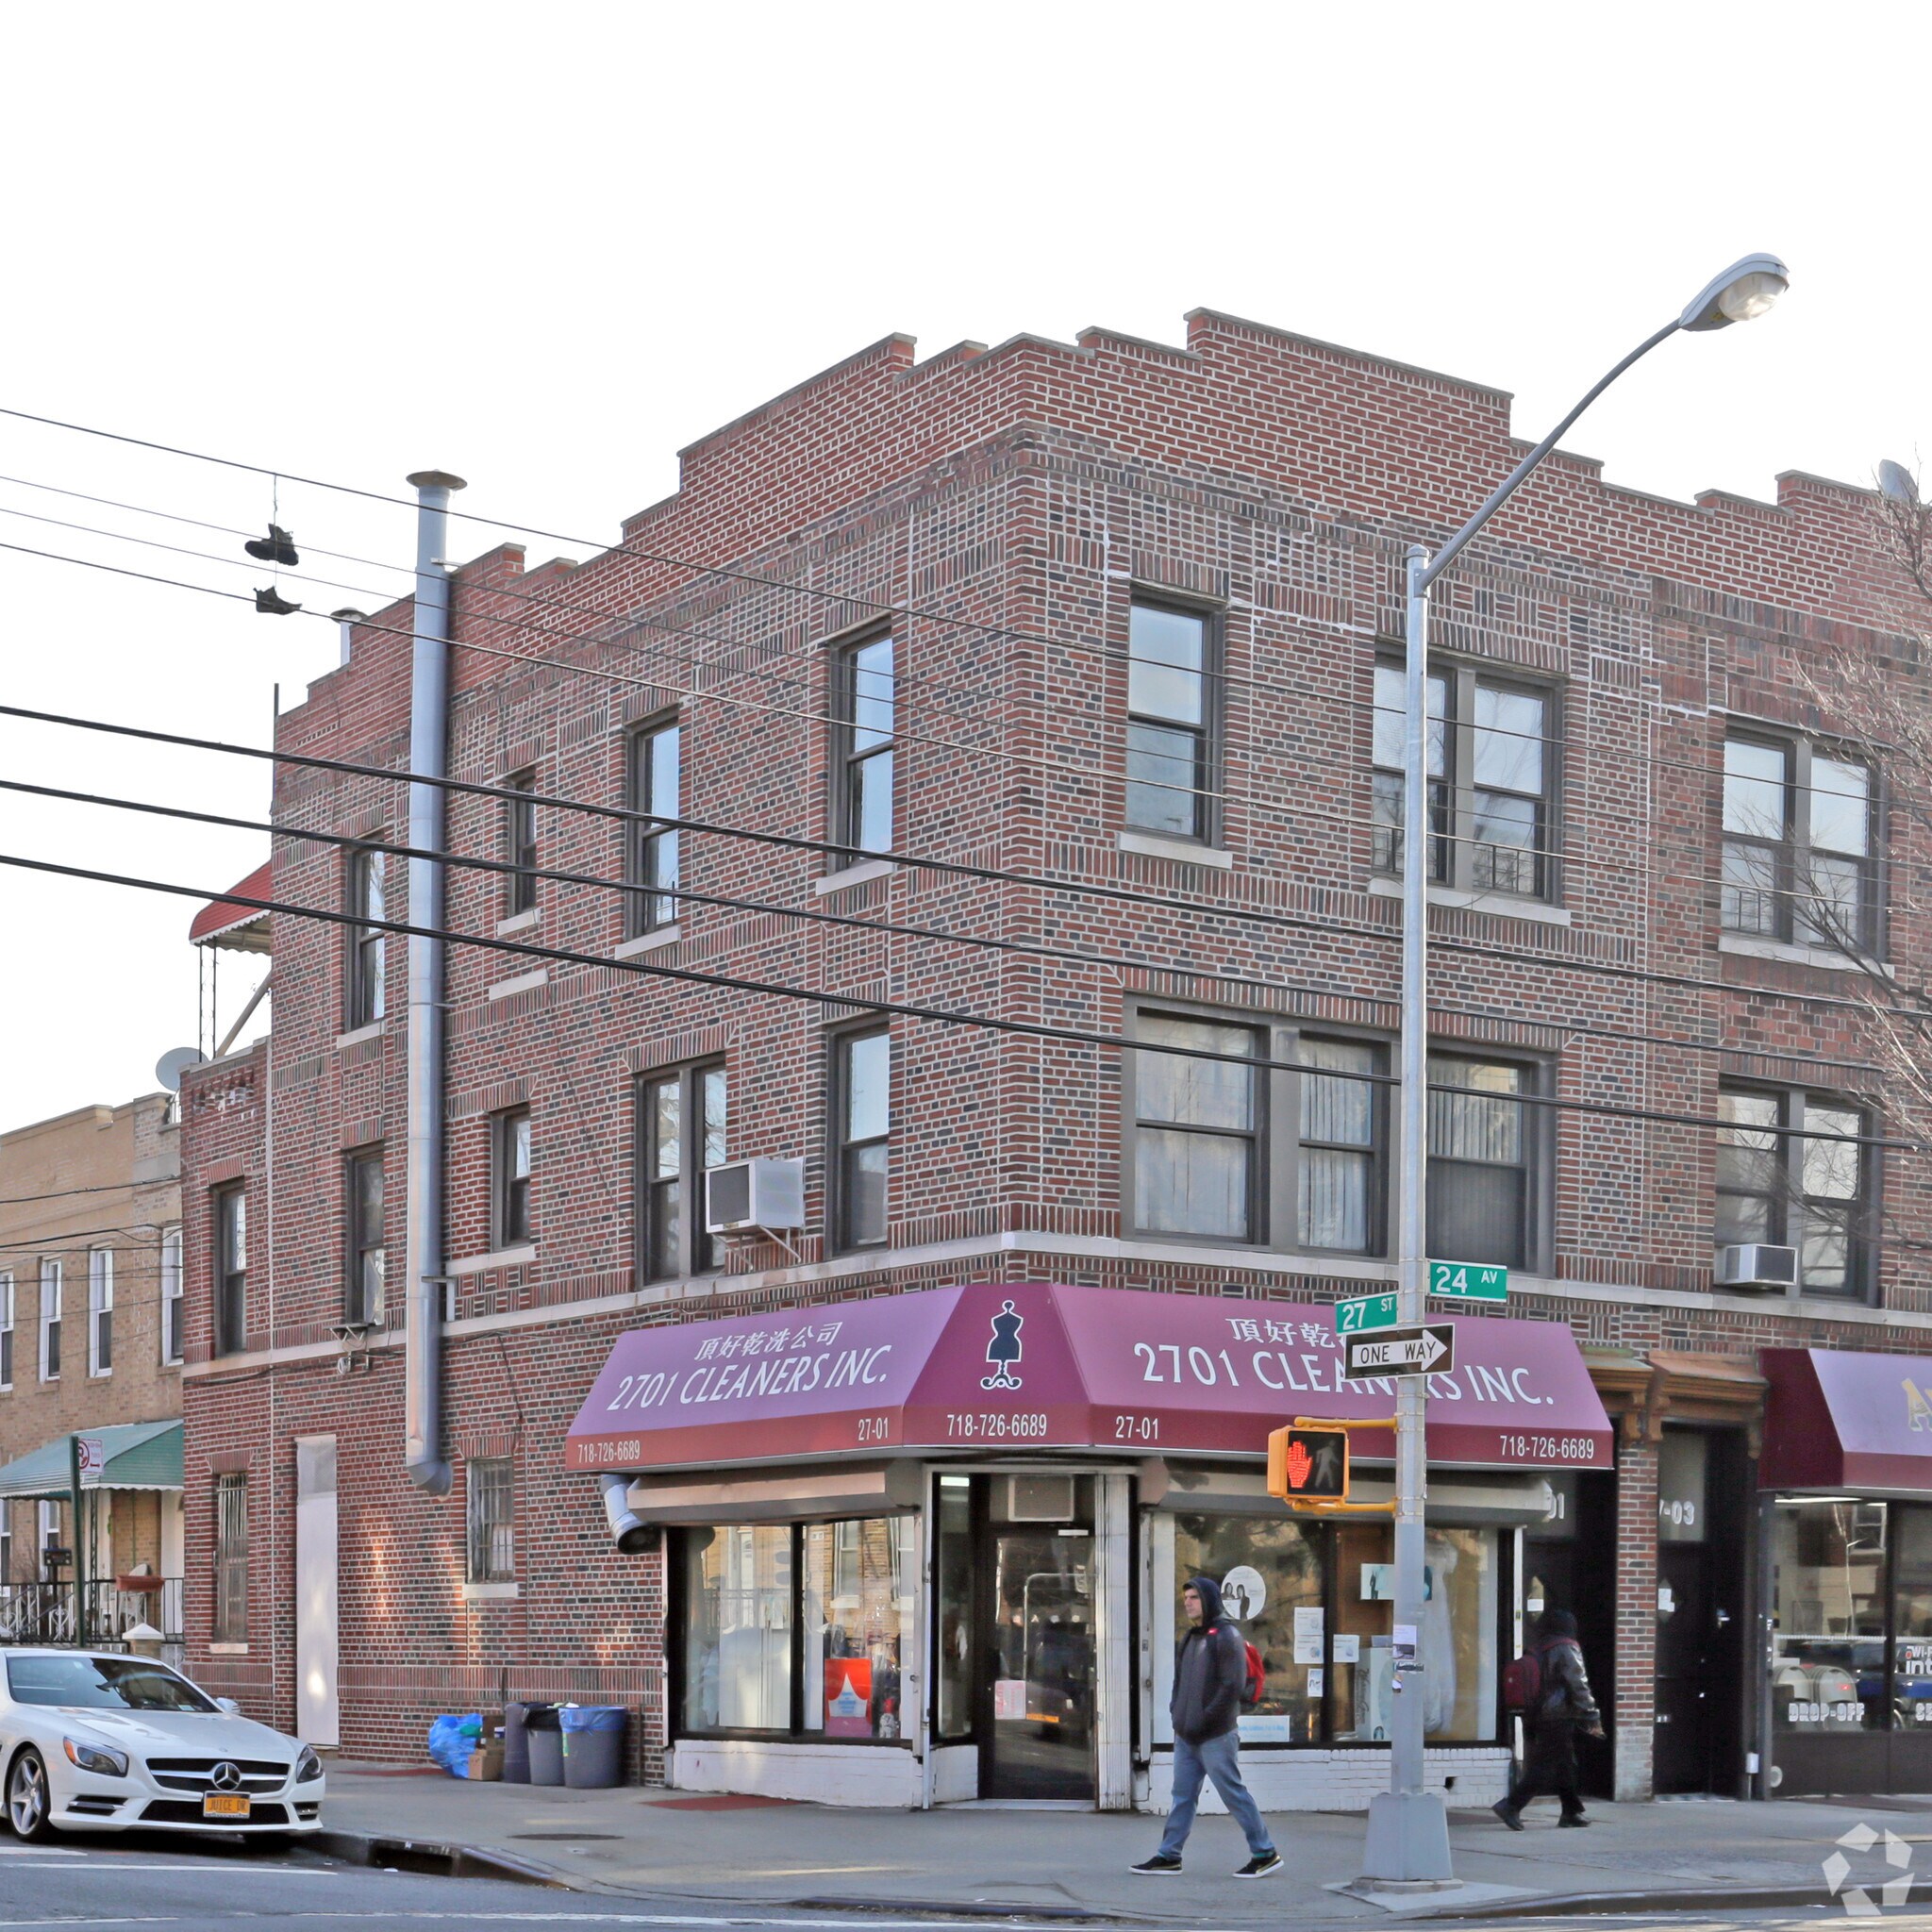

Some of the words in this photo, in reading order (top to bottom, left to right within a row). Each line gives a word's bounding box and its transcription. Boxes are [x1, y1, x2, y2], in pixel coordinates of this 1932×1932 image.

[1435, 1265, 1468, 1293] 24
[1481, 1270, 1498, 1284] AV
[1342, 1302, 1366, 1330] 27
[1381, 1297, 1393, 1311] ST
[694, 1322, 843, 1361] 頂好乾洗公司
[1225, 1318, 1345, 1348] 頂好乾
[1360, 1344, 1390, 1364] ONE
[1405, 1341, 1436, 1360] WAY
[607, 1371, 679, 1410] 2701
[679, 1353, 830, 1404] CLEANERS
[824, 1344, 892, 1389] INC.
[1134, 1342, 1240, 1386] 2701
[1252, 1351, 1462, 1401] CLEARS
[1464, 1365, 1554, 1405] INC.
[858, 1417, 888, 1441] 27-01
[947, 1414, 1047, 1437] 718-726-6689
[1115, 1415, 1158, 1440] 27-01
[577, 1440, 641, 1463] 718-726-6689
[1500, 1435, 1594, 1459] 718-726-6689
[1789, 1702, 1865, 1723] DROP-OFF
[208, 1799, 232, 1811] JUICE
